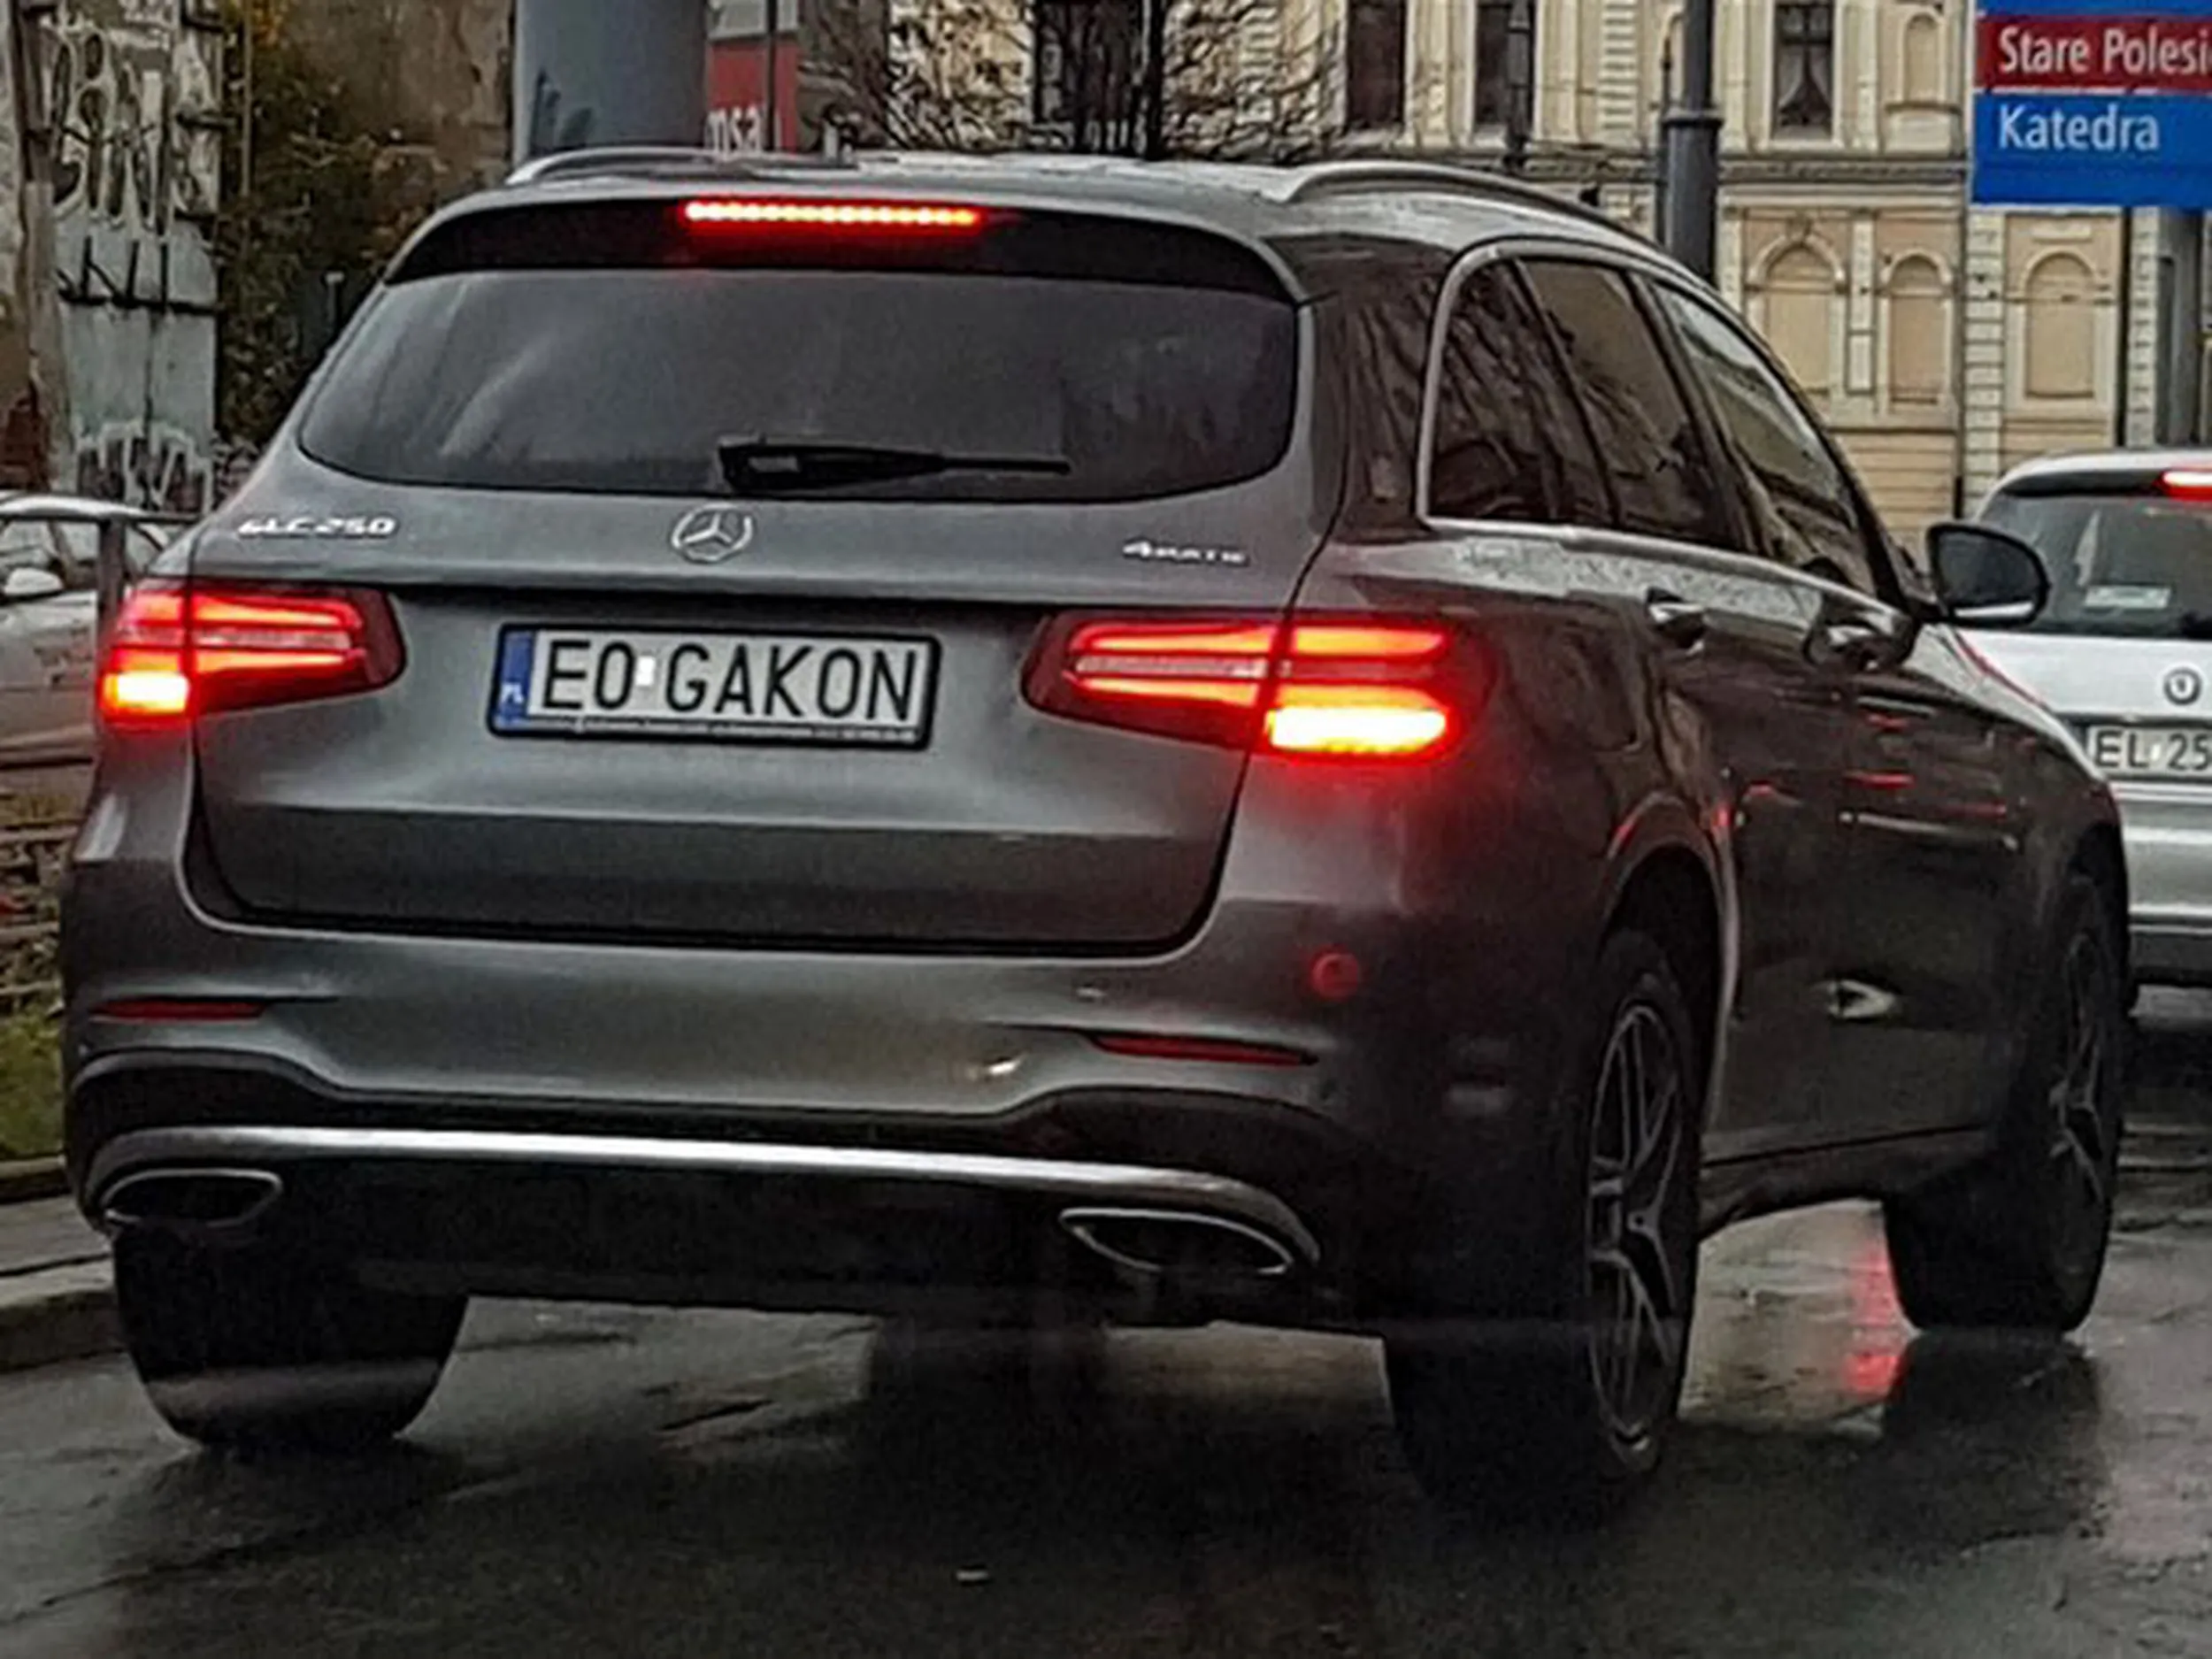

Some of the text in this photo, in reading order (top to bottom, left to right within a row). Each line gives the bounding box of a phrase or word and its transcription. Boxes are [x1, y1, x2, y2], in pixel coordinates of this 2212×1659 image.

[1999, 26, 2212, 74] Stare Polesi
[1999, 103, 2161, 150] Katedra
[664, 642, 917, 721] GAKON
[2095, 730, 2212, 772] EL 25
